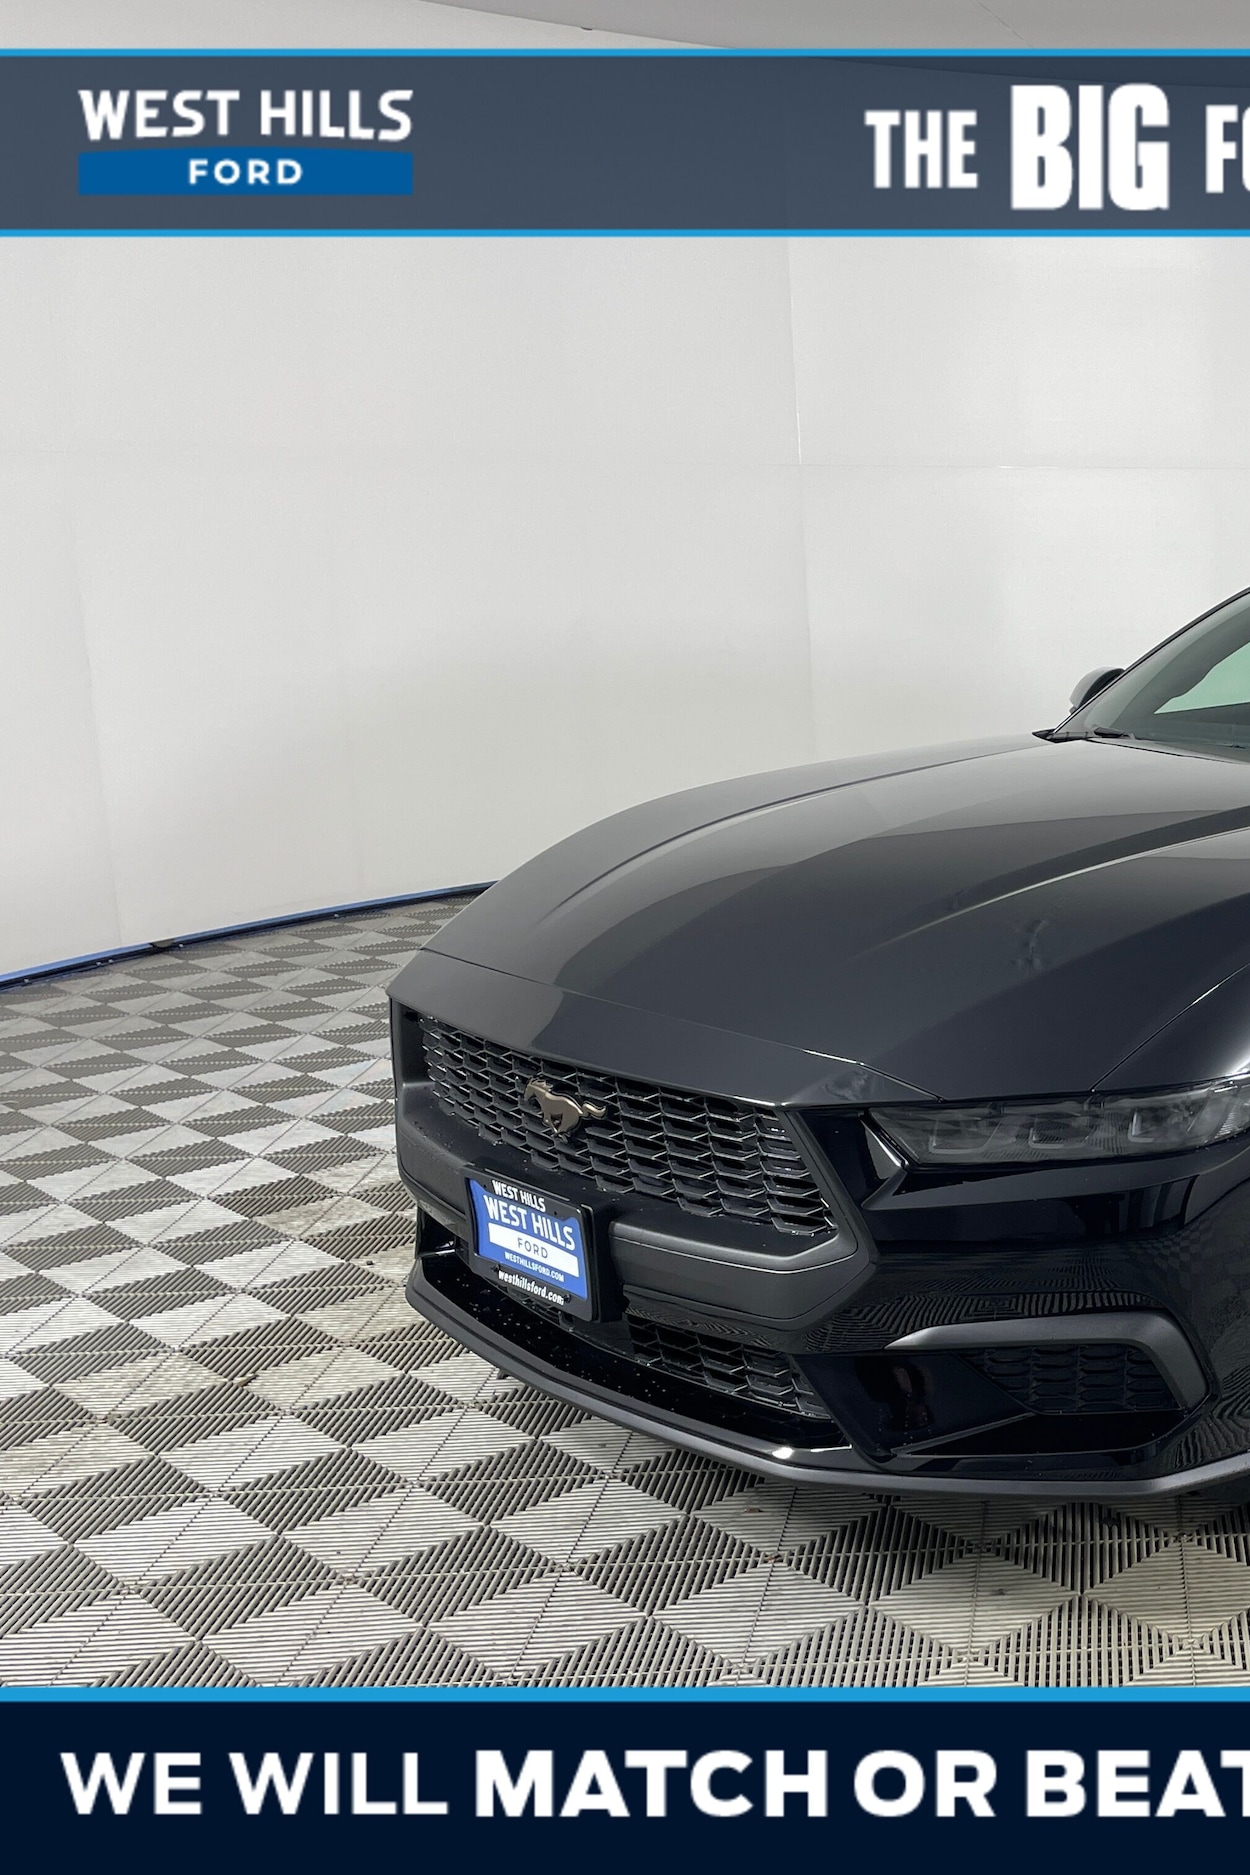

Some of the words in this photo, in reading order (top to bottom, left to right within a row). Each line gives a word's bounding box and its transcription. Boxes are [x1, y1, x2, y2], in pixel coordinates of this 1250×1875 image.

[492, 1180, 518, 1201] WEST
[519, 1190, 546, 1213] HILLS
[483, 1194, 527, 1230] WEST
[531, 1212, 576, 1251] HILLS
[517, 1237, 549, 1259] FORD
[504, 1251, 565, 1283] WESTHILLSFORD.COM
[498, 1270, 565, 1306] westhillsford.com
